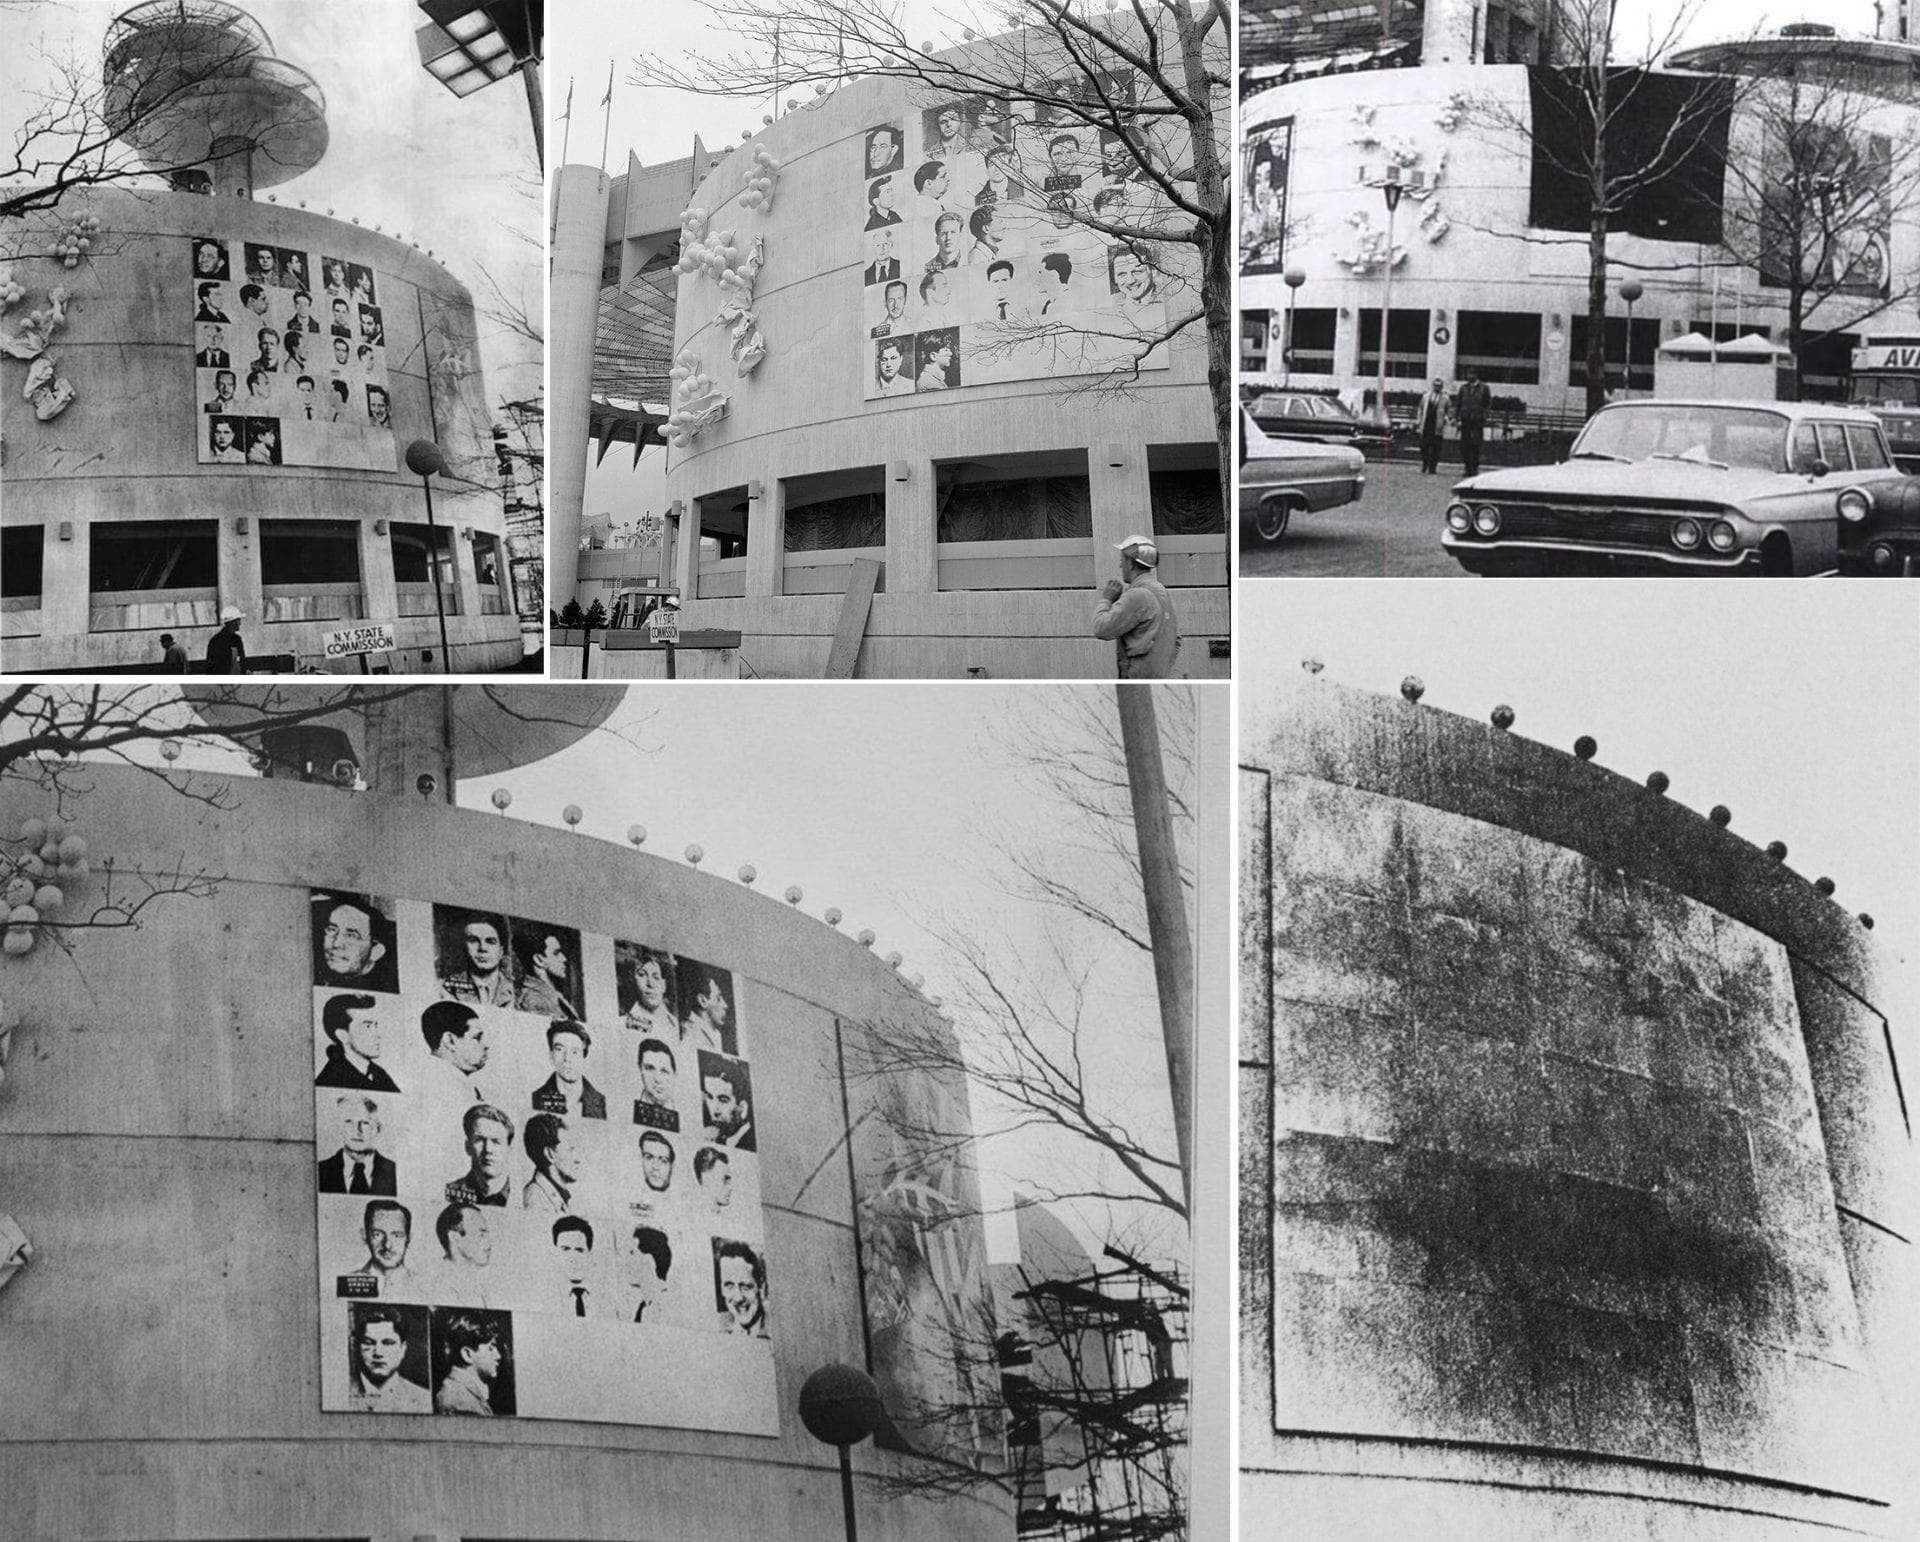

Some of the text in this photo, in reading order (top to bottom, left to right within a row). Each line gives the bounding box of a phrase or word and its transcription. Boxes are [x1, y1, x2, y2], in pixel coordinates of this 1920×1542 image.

[663, 612, 675, 625] STATE
[354, 626, 384, 640] STATE
[651, 626, 678, 639] COMMISSION
[327, 636, 394, 655] COMMISSION
